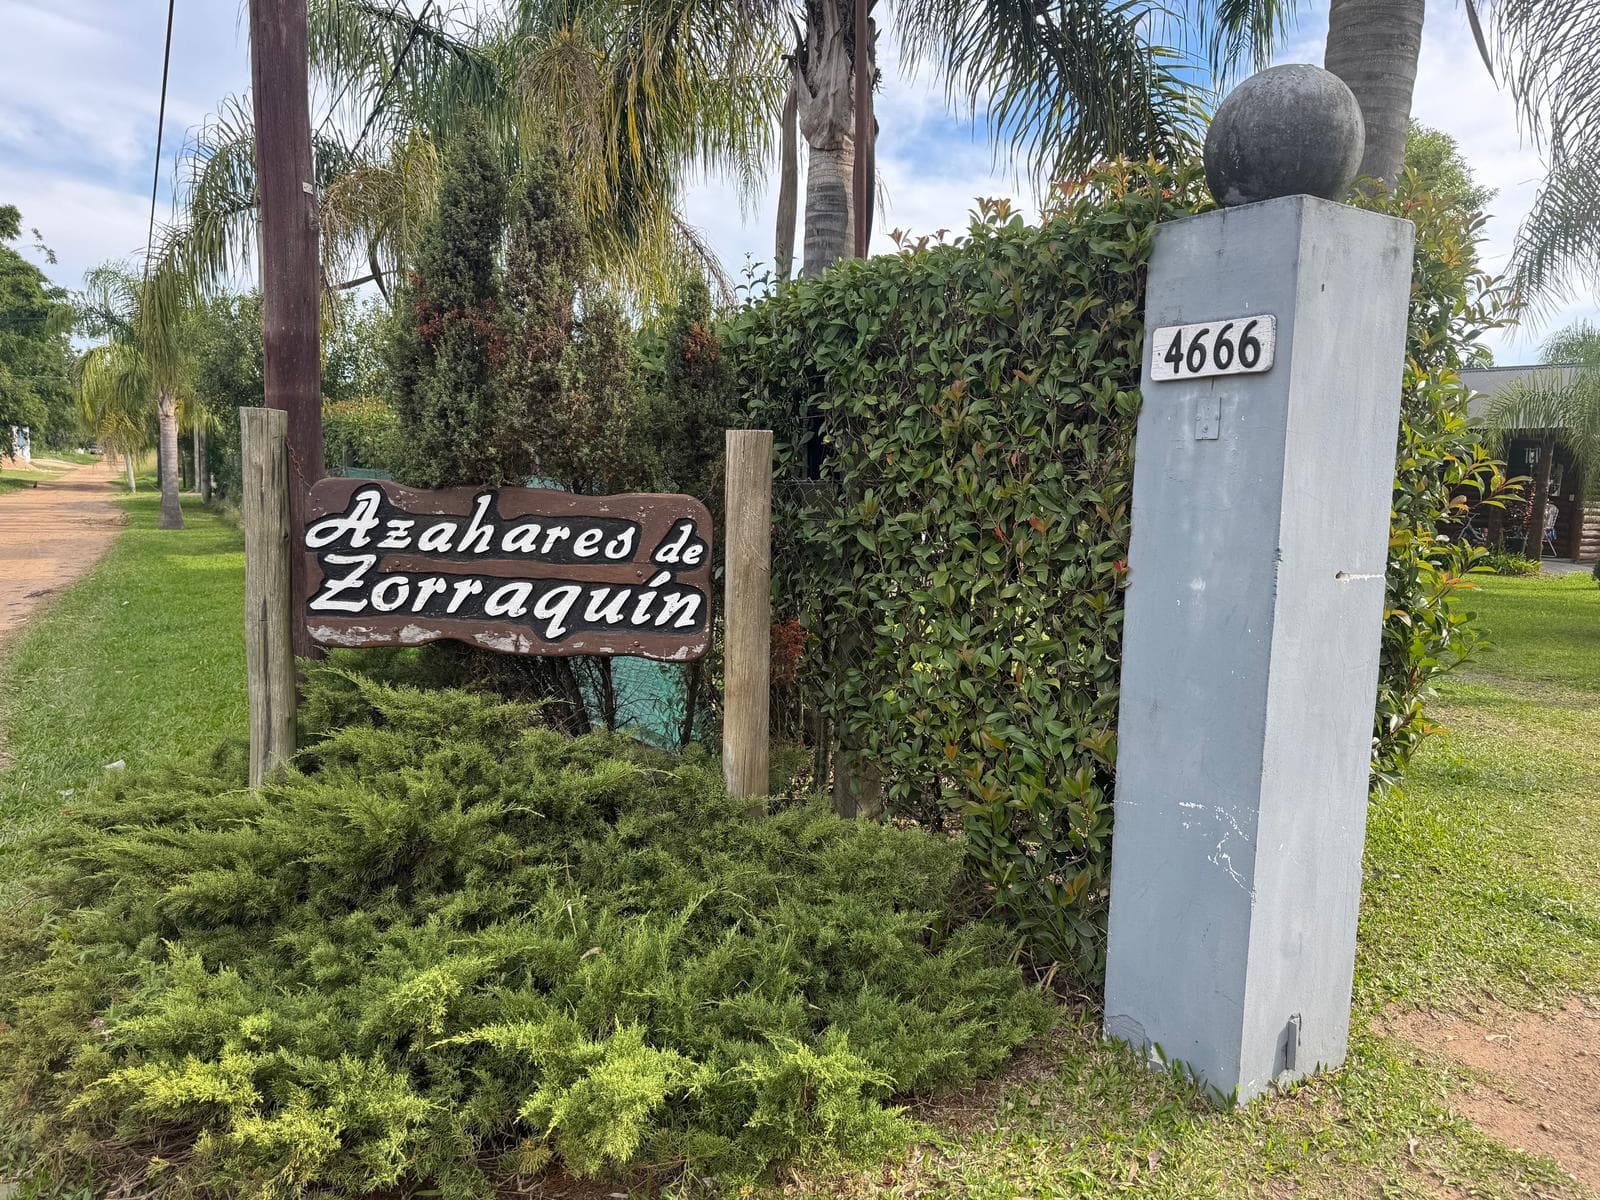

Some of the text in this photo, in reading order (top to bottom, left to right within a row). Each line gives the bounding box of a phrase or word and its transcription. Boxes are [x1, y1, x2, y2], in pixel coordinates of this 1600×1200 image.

[1164, 319, 1261, 374] 4666
[305, 489, 703, 565] Azahares de
[309, 553, 702, 640] Zorraquín
